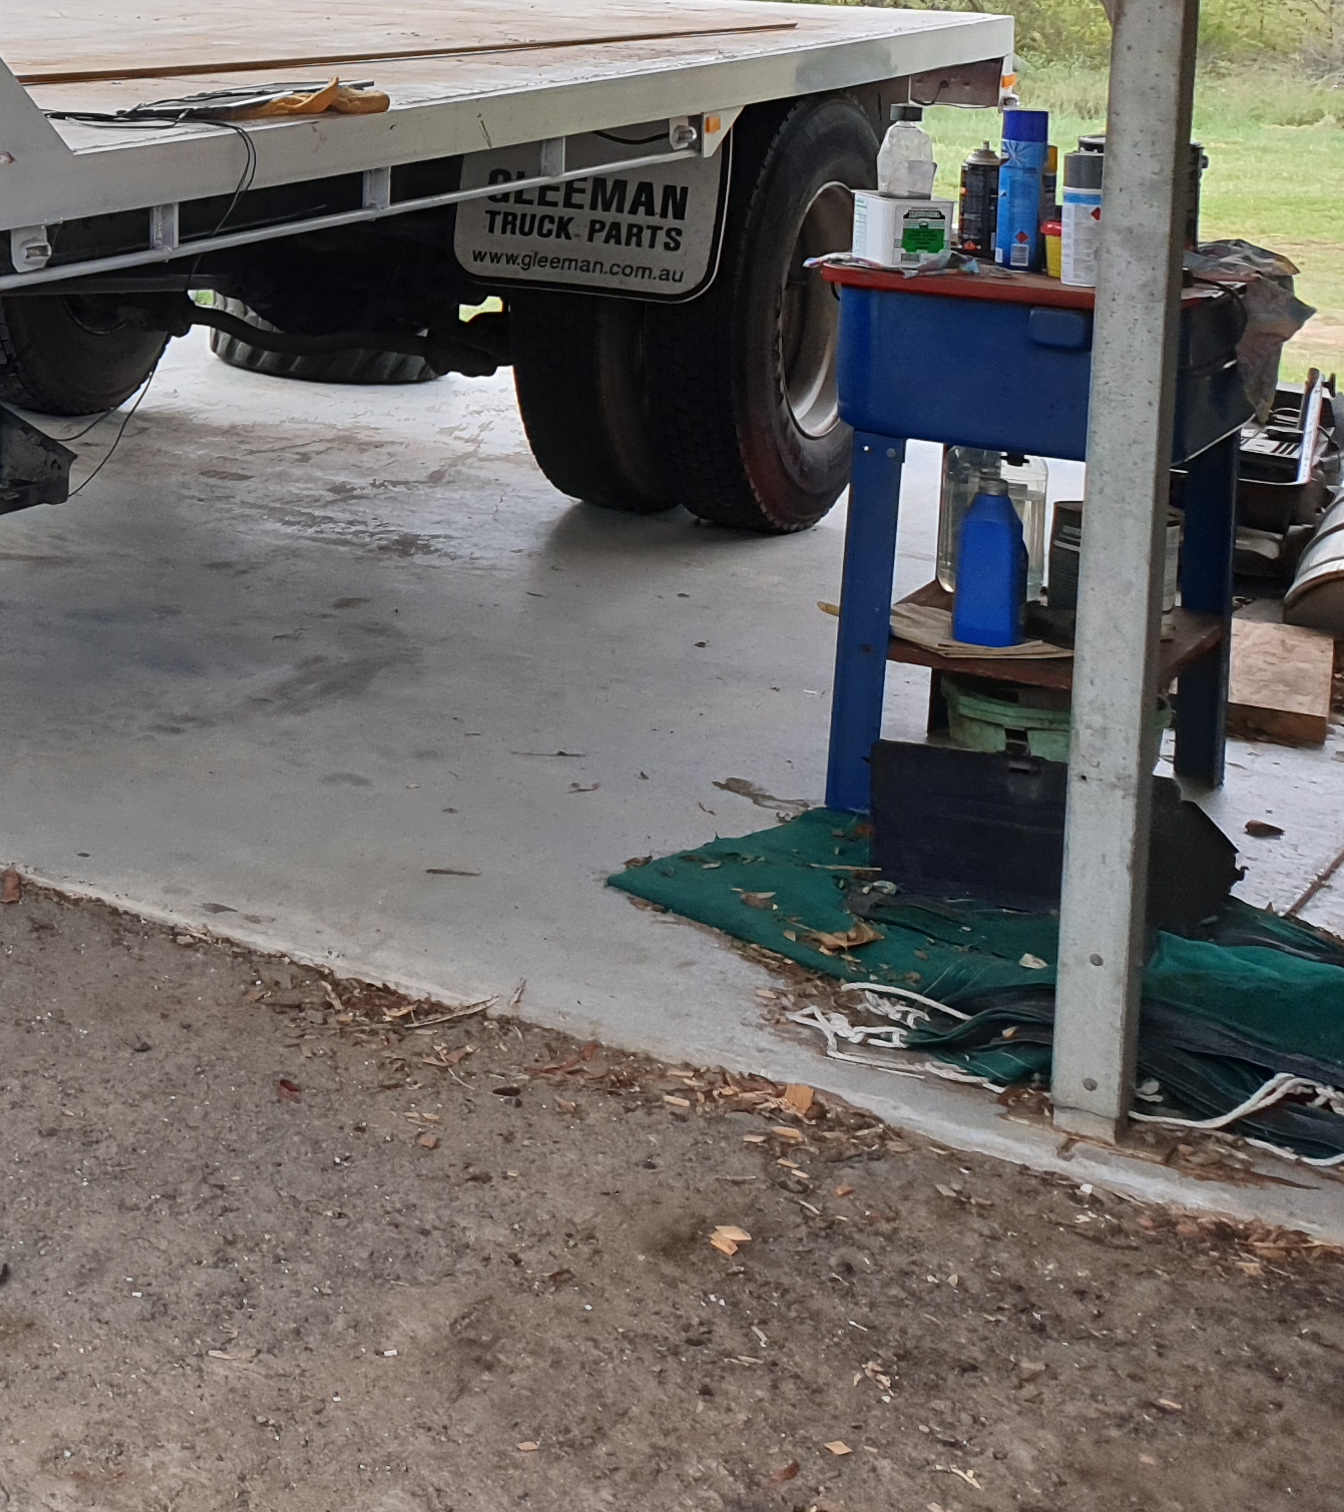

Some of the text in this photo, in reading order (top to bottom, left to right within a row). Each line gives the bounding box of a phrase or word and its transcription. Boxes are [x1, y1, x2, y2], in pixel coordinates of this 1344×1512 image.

[487, 168, 689, 222] GLEEMAN
[484, 208, 684, 253] TRUCK PARTS
[471, 248, 685, 284] www.gleeman.com.au
